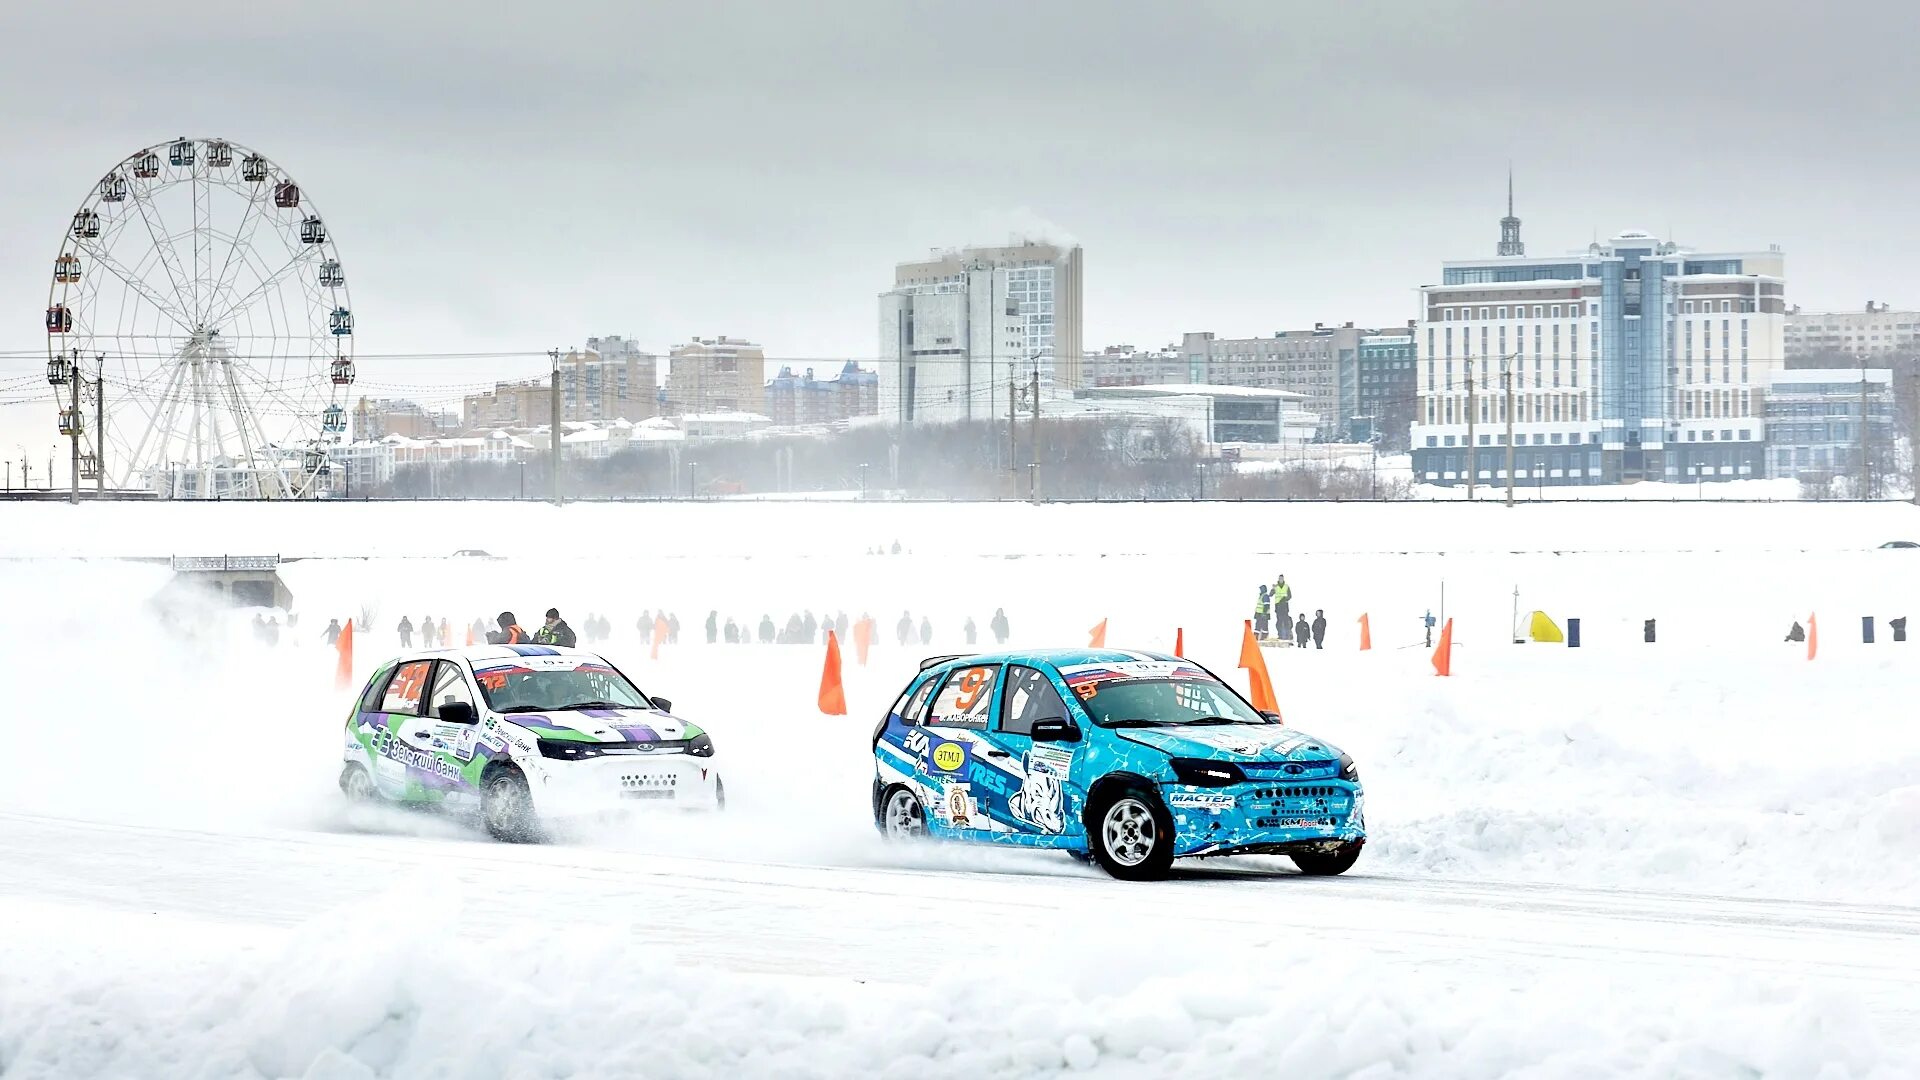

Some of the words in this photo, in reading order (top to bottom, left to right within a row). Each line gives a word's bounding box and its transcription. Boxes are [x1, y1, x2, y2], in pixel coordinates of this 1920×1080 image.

[956, 667, 985, 709] 9
[1076, 681, 1099, 701] 9
[392, 740, 434, 772] Земский
[435, 757, 460, 781] банк
[1171, 794, 1233, 803] МАСТЕР
